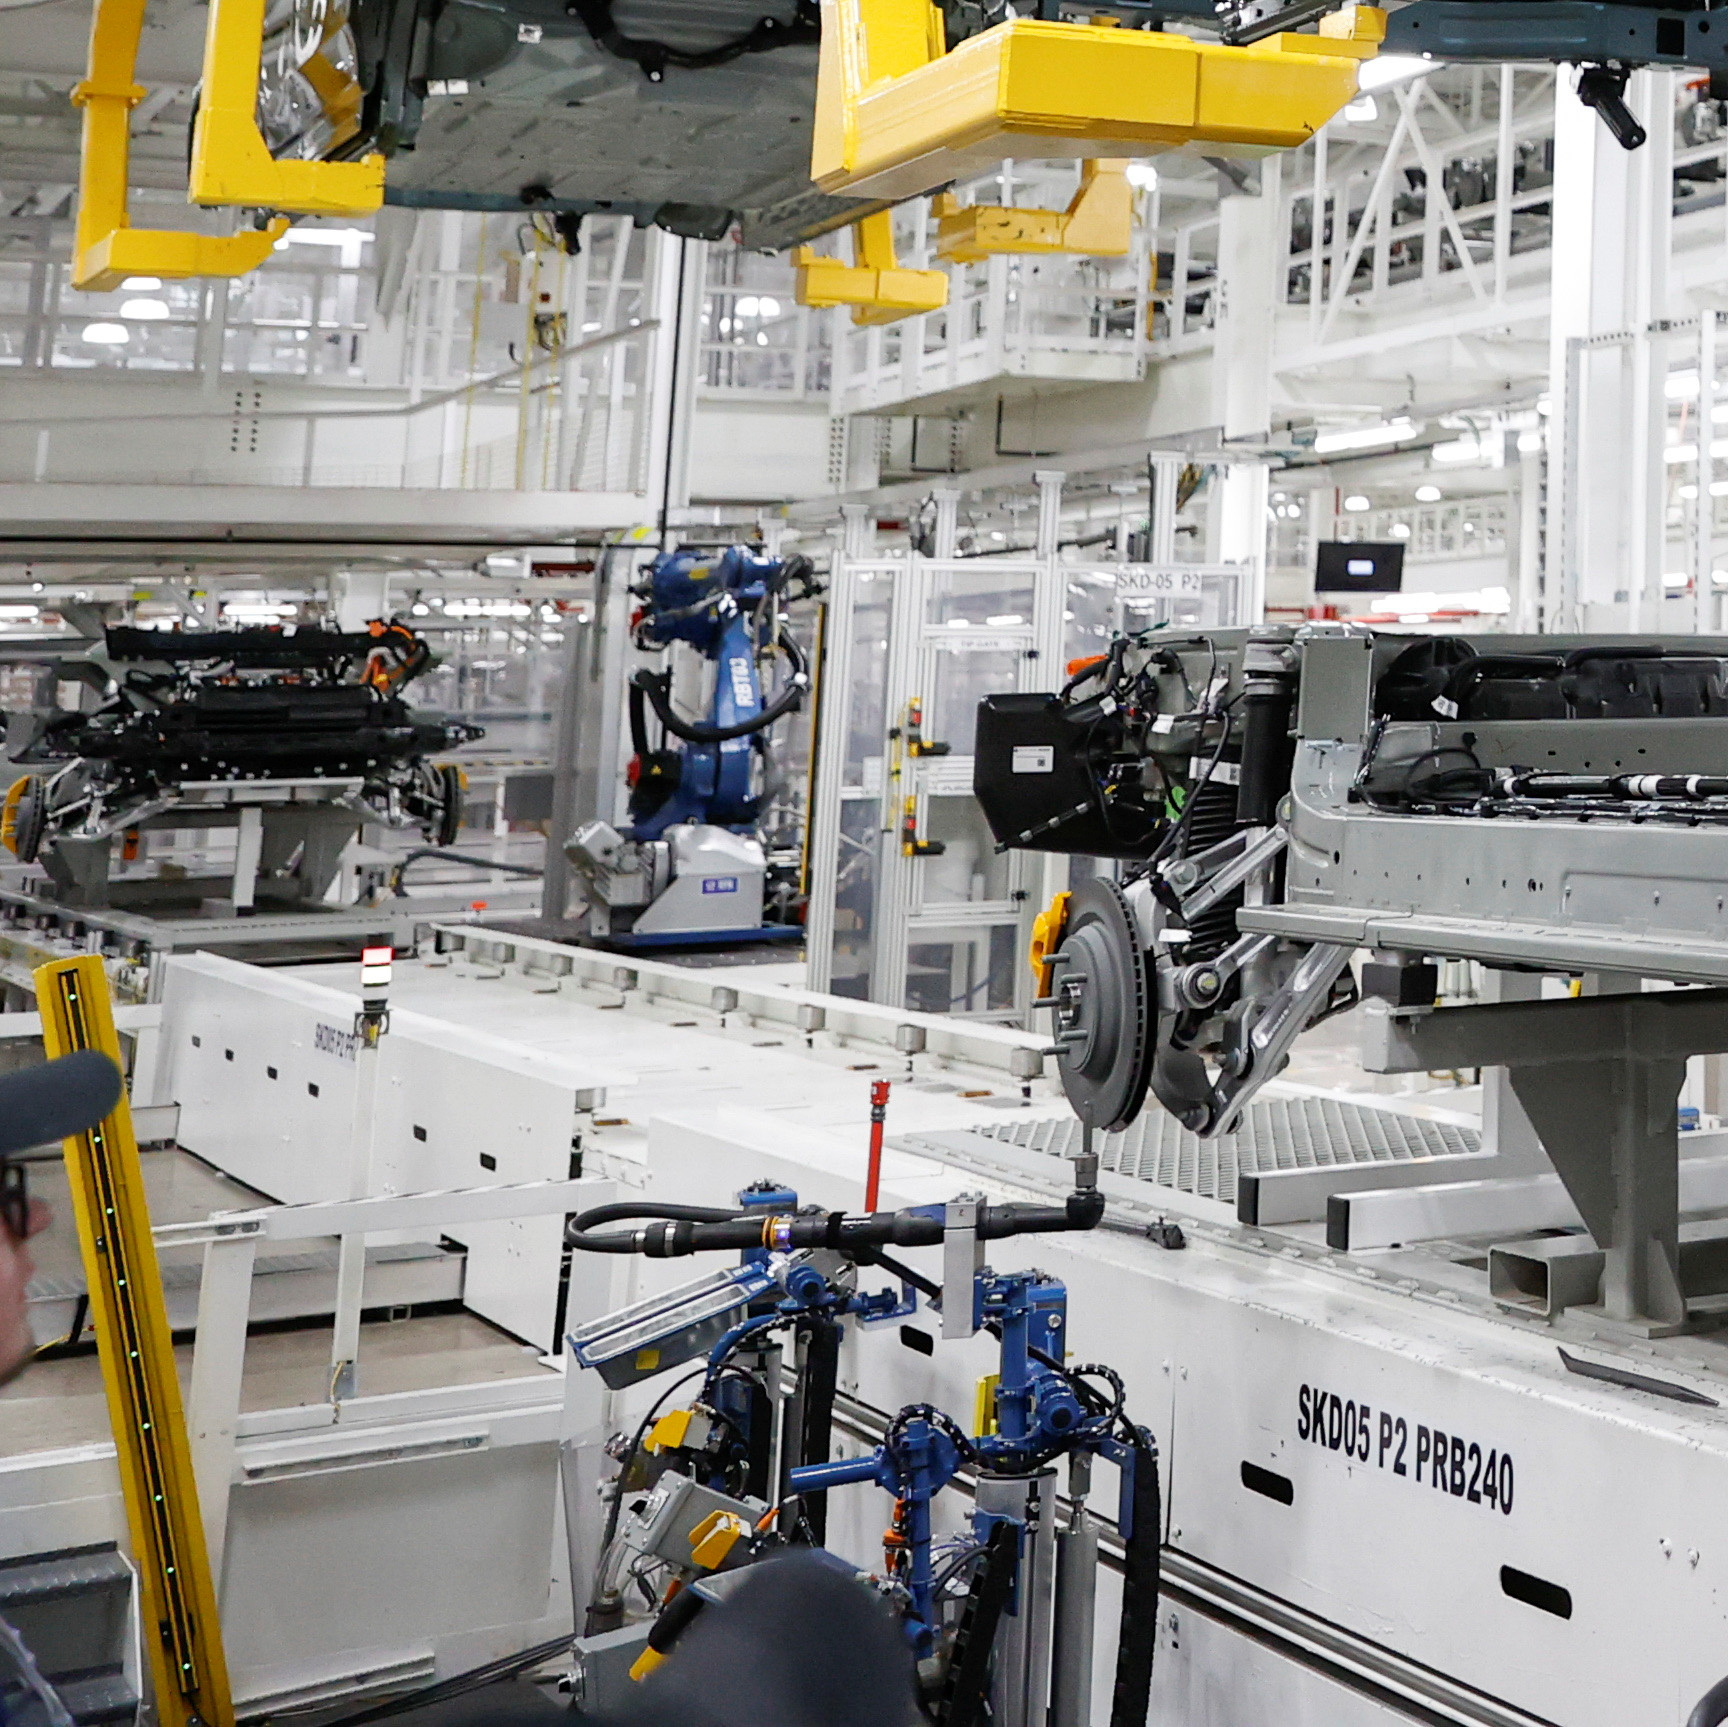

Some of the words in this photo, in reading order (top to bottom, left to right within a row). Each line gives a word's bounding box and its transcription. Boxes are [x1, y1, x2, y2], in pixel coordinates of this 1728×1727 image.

[1118, 573, 1173, 590] SKD-05
[729, 657, 755, 707] RBT03
[1298, 1383, 1371, 1462] SKD05
[1378, 1410, 1408, 1477] P2
[1416, 1424, 1514, 1515] PRB240
